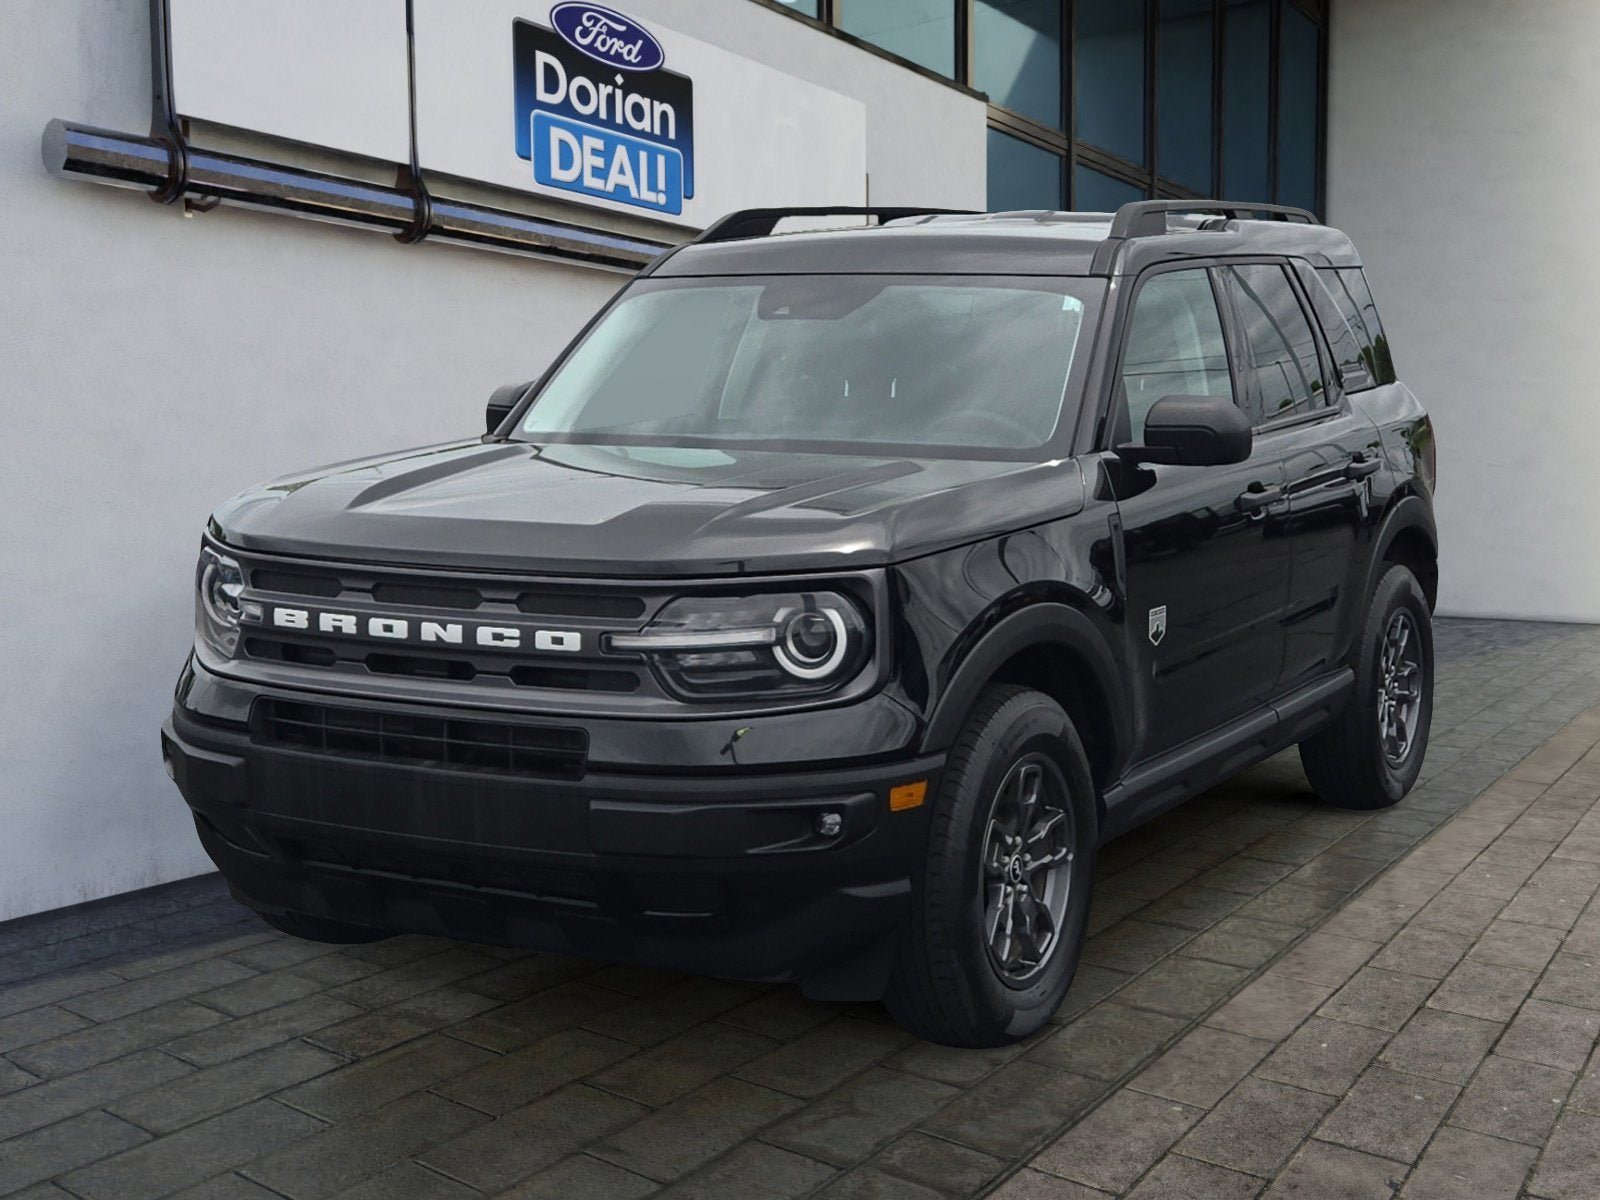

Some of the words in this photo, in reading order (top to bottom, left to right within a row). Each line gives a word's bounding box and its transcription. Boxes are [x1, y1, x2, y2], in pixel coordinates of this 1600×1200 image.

[575, 12, 643, 63] Ford
[535, 50, 676, 140] Dorian
[550, 126, 667, 206] DEAL!
[273, 607, 582, 652] BRONCO
